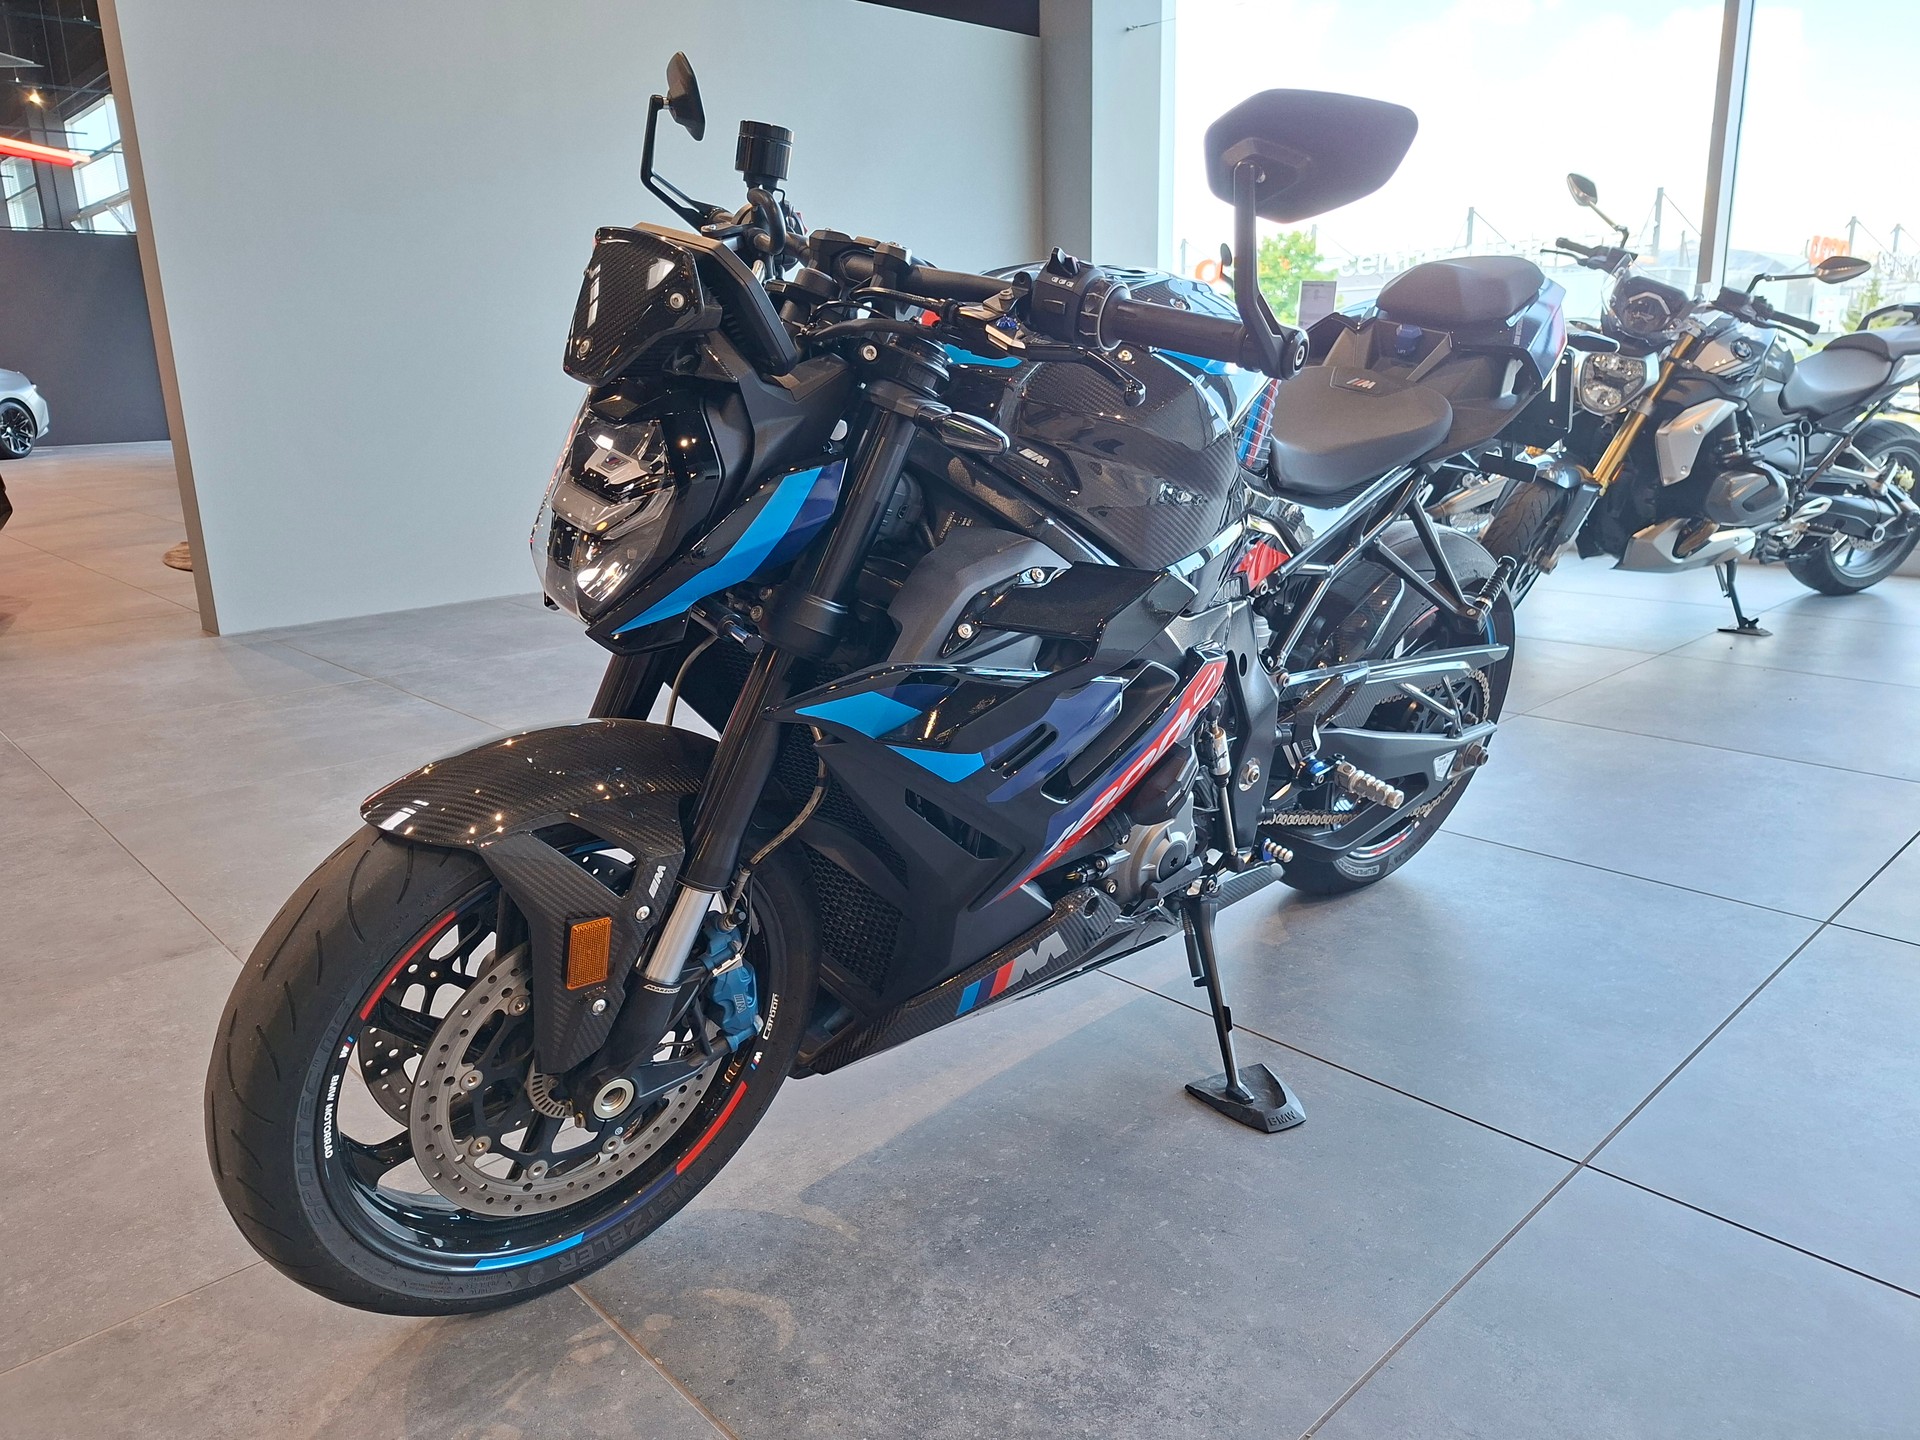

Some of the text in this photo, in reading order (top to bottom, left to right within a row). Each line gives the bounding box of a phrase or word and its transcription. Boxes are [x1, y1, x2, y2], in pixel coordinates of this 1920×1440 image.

[762, 992, 780, 1041] Carbon
[323, 1074, 340, 1159] BMW MOTORRAD
[1267, 1110, 1297, 1127] BMW
[558, 1170, 699, 1273] METZELER
